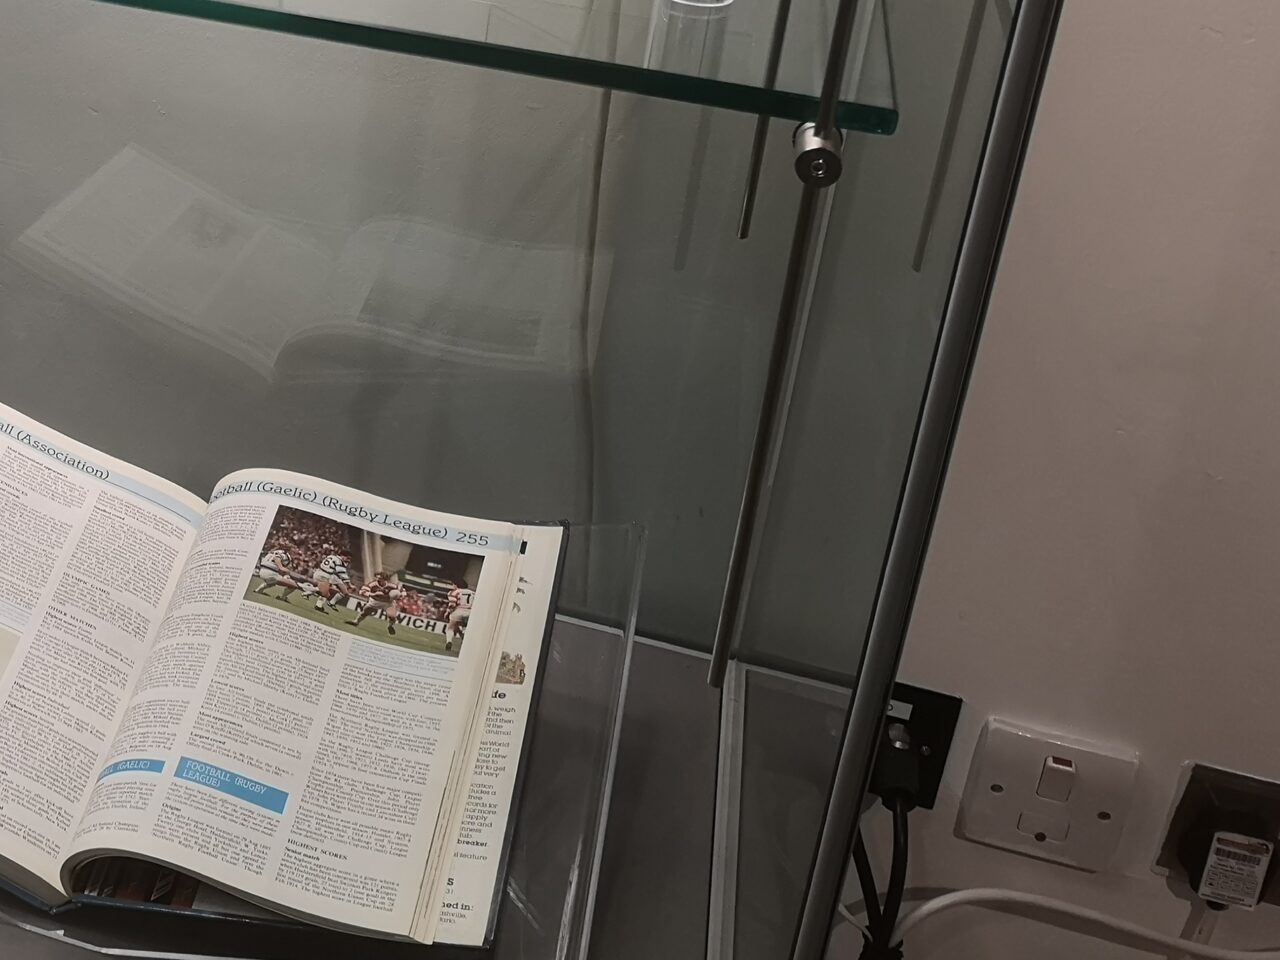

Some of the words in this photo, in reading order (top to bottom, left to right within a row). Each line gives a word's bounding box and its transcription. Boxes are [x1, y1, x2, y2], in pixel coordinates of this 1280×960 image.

[16, 429, 110, 481] (Association)
[213, 481, 253, 499] otball
[257, 480, 317, 503] (Gaelic)
[322, 495, 379, 522] (Rugby
[382, 514, 448, 539] League)
[455, 531, 489, 546] 255
[354, 601, 437, 632] NWICH
[117, 760, 151, 770] (GAELIC)
[183, 770, 220, 788] LEAGUE)
[185, 761, 231, 783] FOOTBALL
[234, 776, 268, 794] (RUGBY
[477, 820, 493, 828] and
[287, 838, 318, 853] HIGHEST
[320, 849, 348, 861] SCORES
[457, 838, 488, 847] breaker
[303, 852, 320, 861] match
